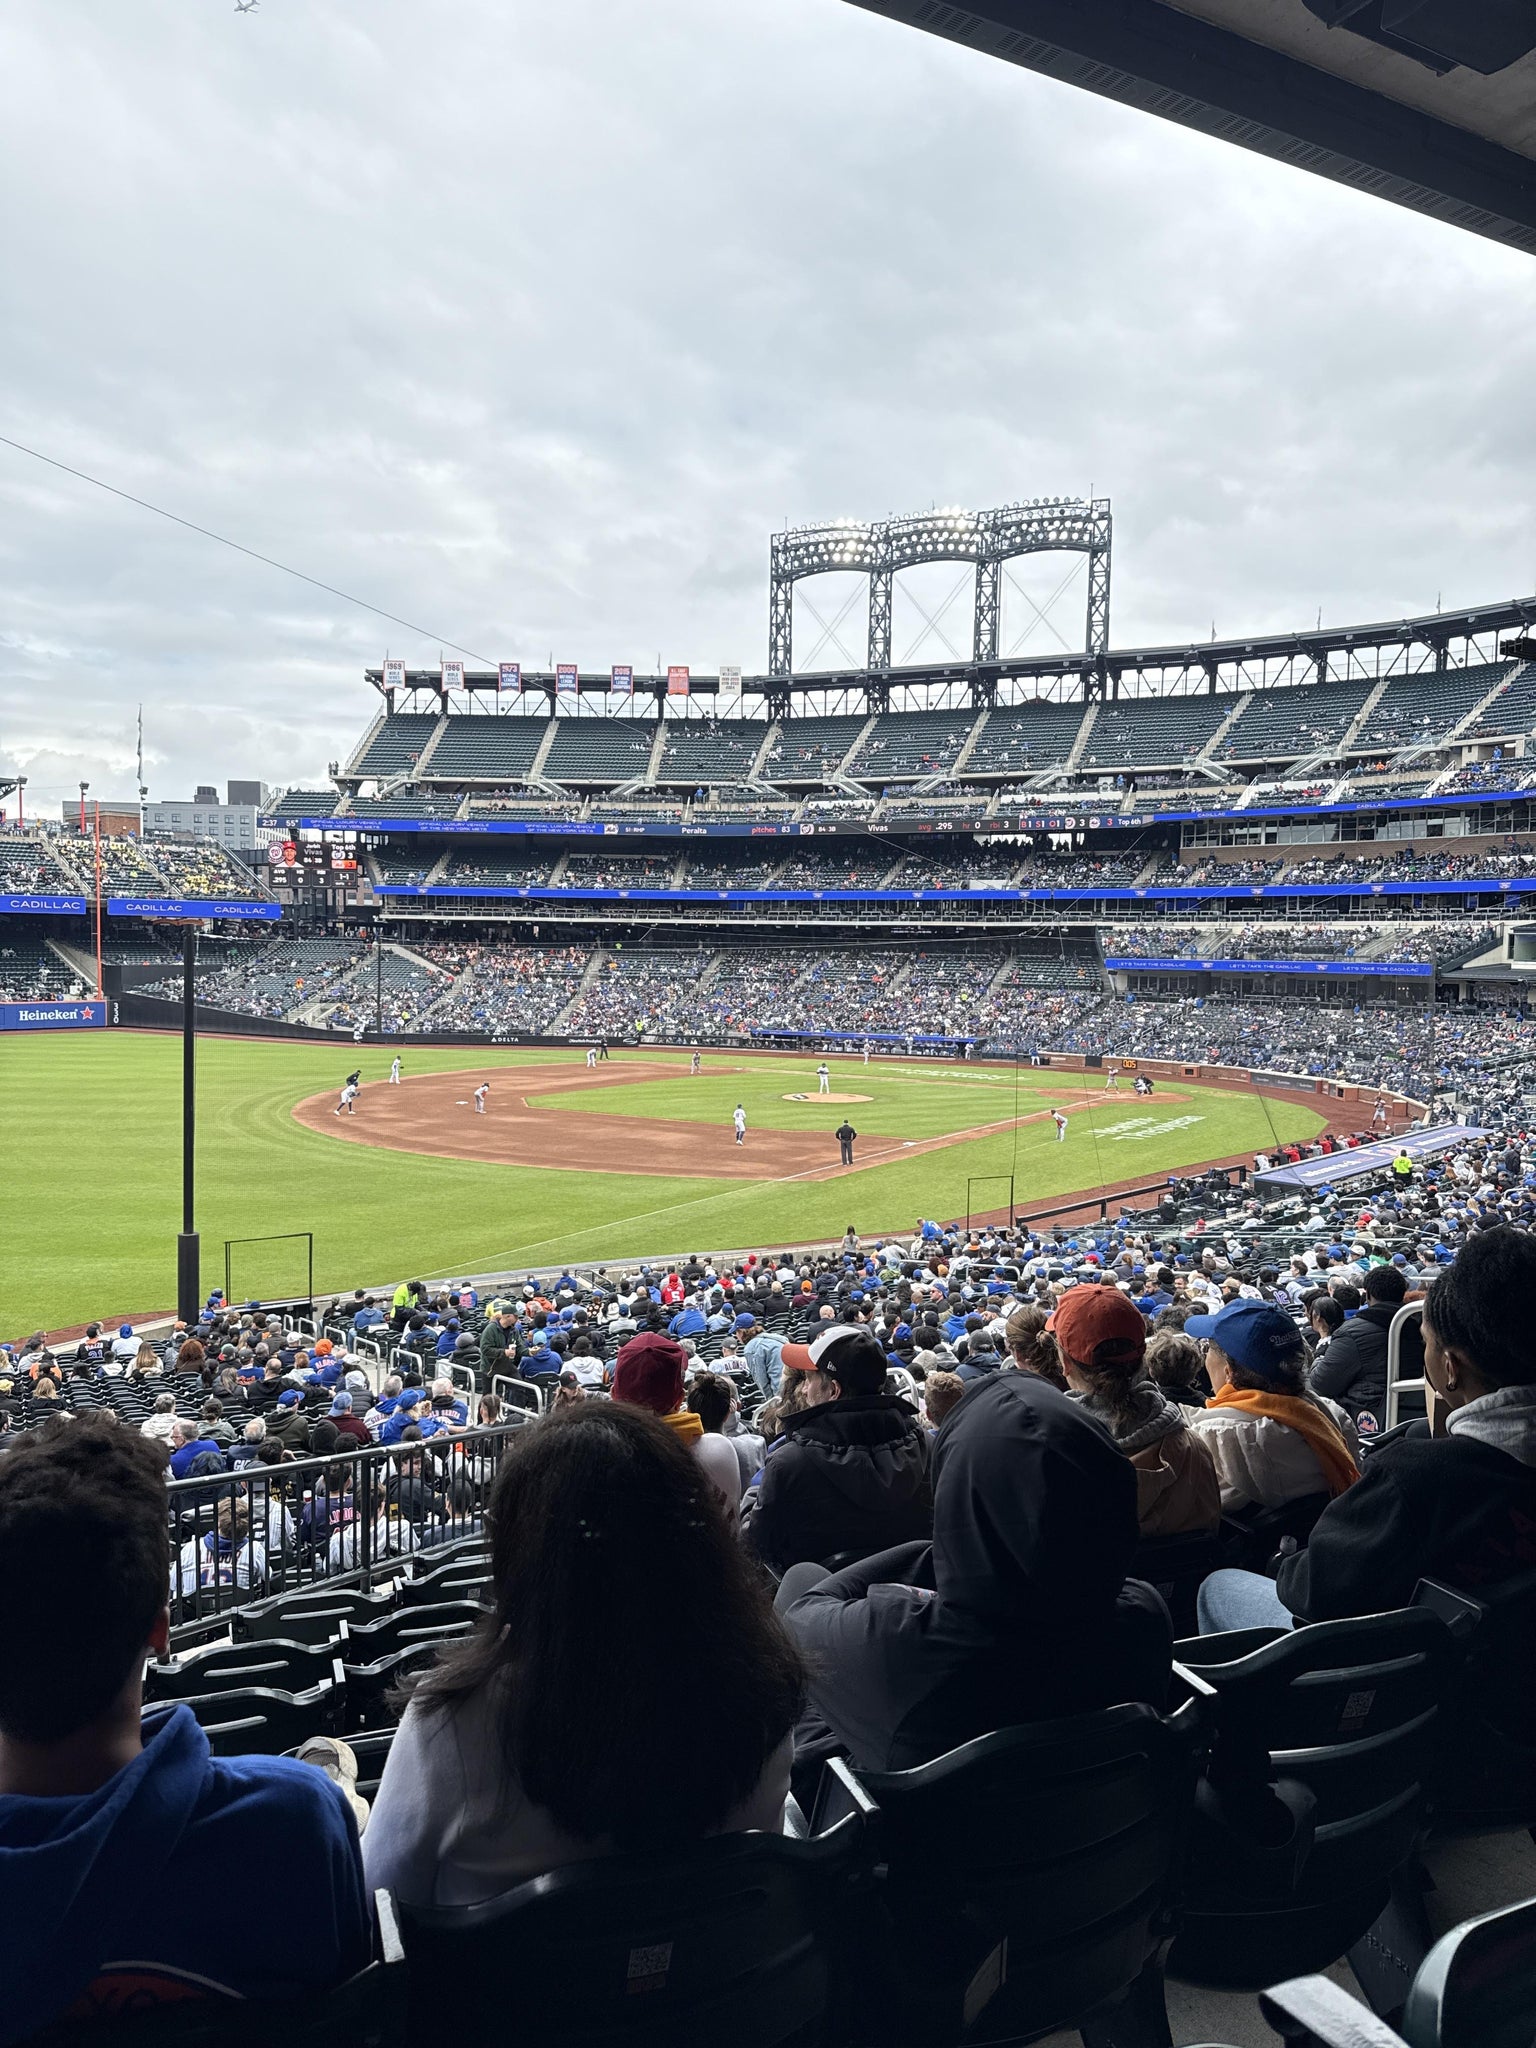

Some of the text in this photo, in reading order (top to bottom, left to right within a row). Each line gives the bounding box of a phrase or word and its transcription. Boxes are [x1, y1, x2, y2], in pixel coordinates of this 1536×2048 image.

[990, 820, 1000, 828] rbi
[752, 826, 776, 834] pitches
[10, 900, 81, 910] CADILLAC
[126, 903, 182, 912] CADILLAC
[214, 906, 266, 915] CADILLAC
[19, 1009, 77, 1022] Heineken
[671, 1290, 680, 1302] 5
[1273, 1290, 1290, 1305] 12
[724, 1360, 747, 1372] ALONSO
